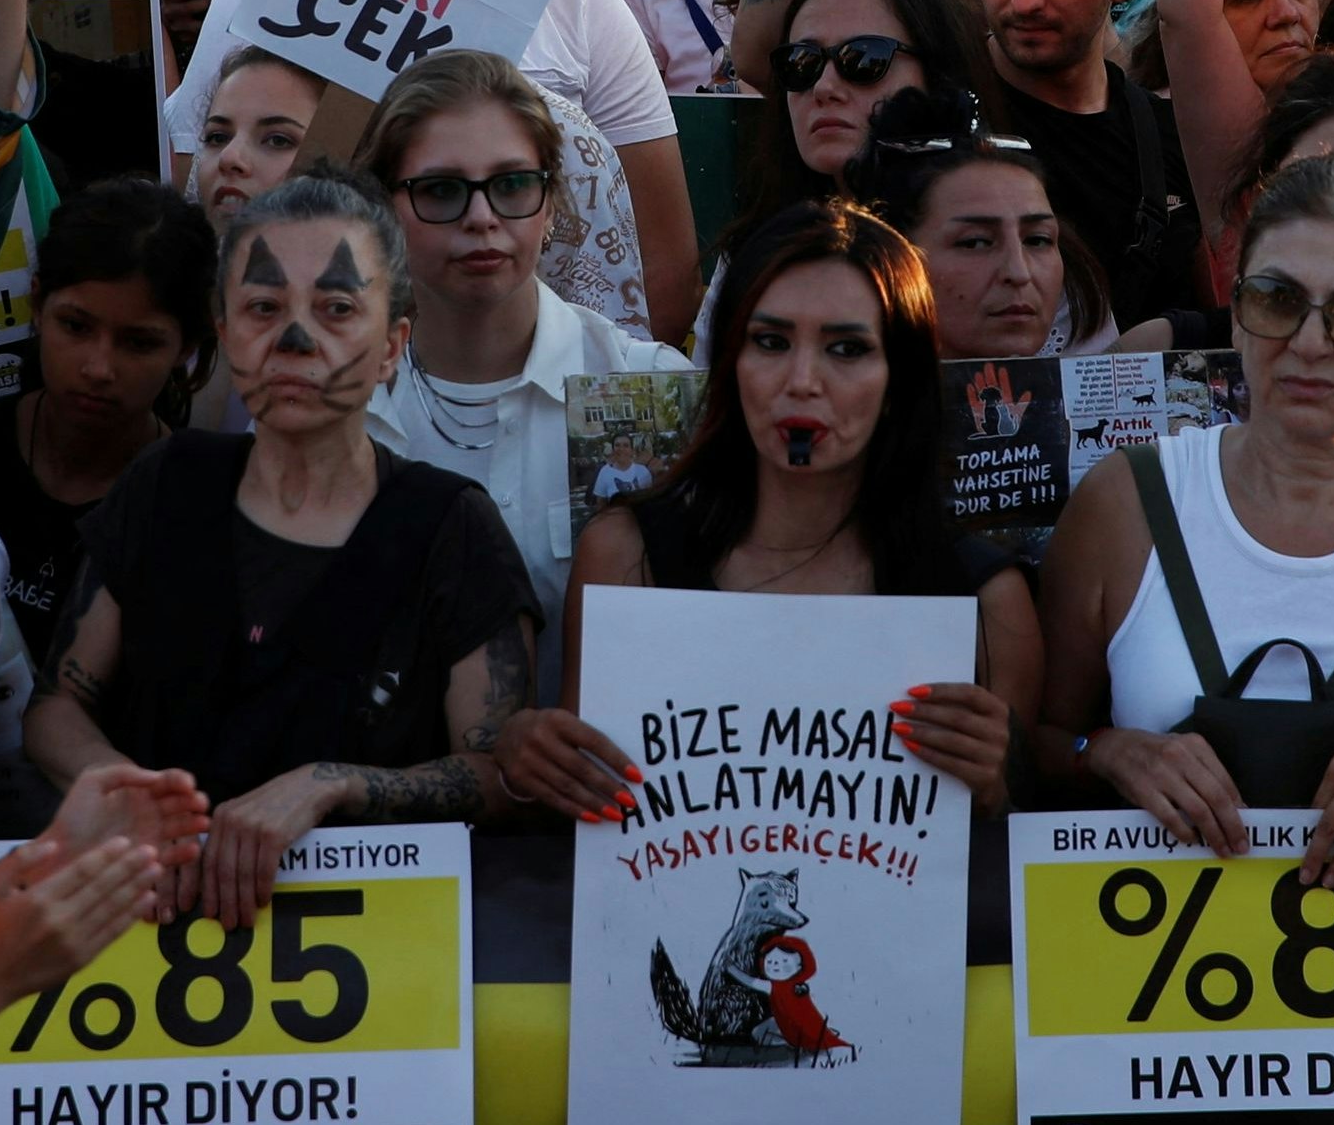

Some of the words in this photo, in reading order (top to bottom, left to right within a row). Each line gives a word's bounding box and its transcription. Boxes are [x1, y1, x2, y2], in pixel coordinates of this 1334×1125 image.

[1112, 416, 1153, 432] Artık
[956, 443, 1041, 471] TOPLAMA
[954, 495, 991, 516] DUR
[998, 490, 1022, 509] DE
[642, 699, 741, 766] BİZE
[759, 705, 905, 763] MASAL
[1052, 824, 1097, 852] BİR
[314, 840, 421, 871] İSTİYOR
[1130, 1052, 1292, 1100] HAYIR
[12, 1081, 169, 1125] HAYIR
[185, 1068, 359, 1123] DİYOR!
